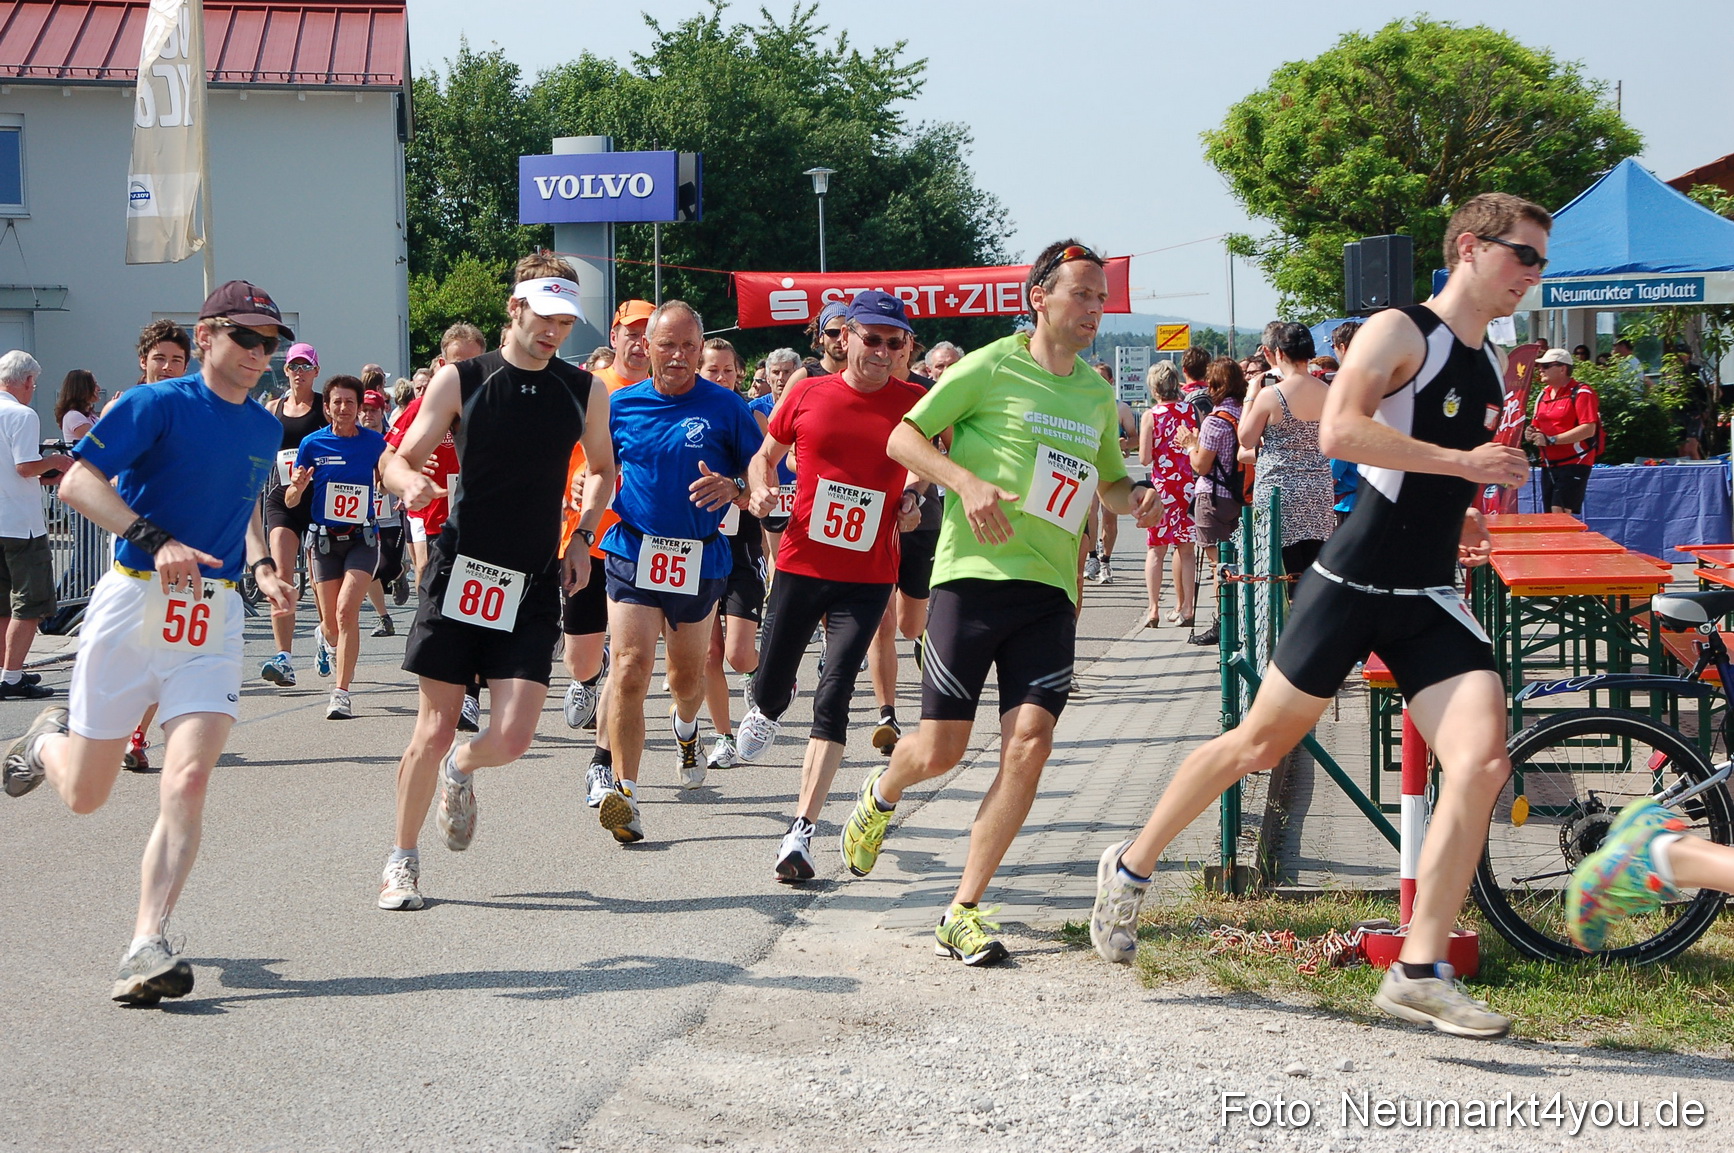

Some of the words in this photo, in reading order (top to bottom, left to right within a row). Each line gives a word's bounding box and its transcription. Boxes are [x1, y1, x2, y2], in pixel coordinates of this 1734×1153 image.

[533, 172, 654, 200] VOLVO
[1550, 285, 1633, 303] Neumarkter
[1635, 282, 1697, 301] Tagblatt
[1031, 425, 1042, 435] IN
[1043, 427, 1072, 442] BESTEN
[1047, 458, 1078, 476] WERBUNG
[1048, 450, 1079, 470] MEYER
[827, 491, 859, 503] WERBUNG
[828, 484, 860, 498] MEYER
[1046, 470, 1080, 518] 77
[333, 494, 360, 519] 92
[823, 501, 867, 543] 58
[651, 537, 681, 548] MEYER
[651, 544, 680, 553] WERBUNG
[464, 568, 498, 583] WERBUNG
[466, 561, 500, 578] MEYER
[649, 552, 687, 588] 85
[458, 579, 506, 622] 80
[162, 598, 211, 647] 56
